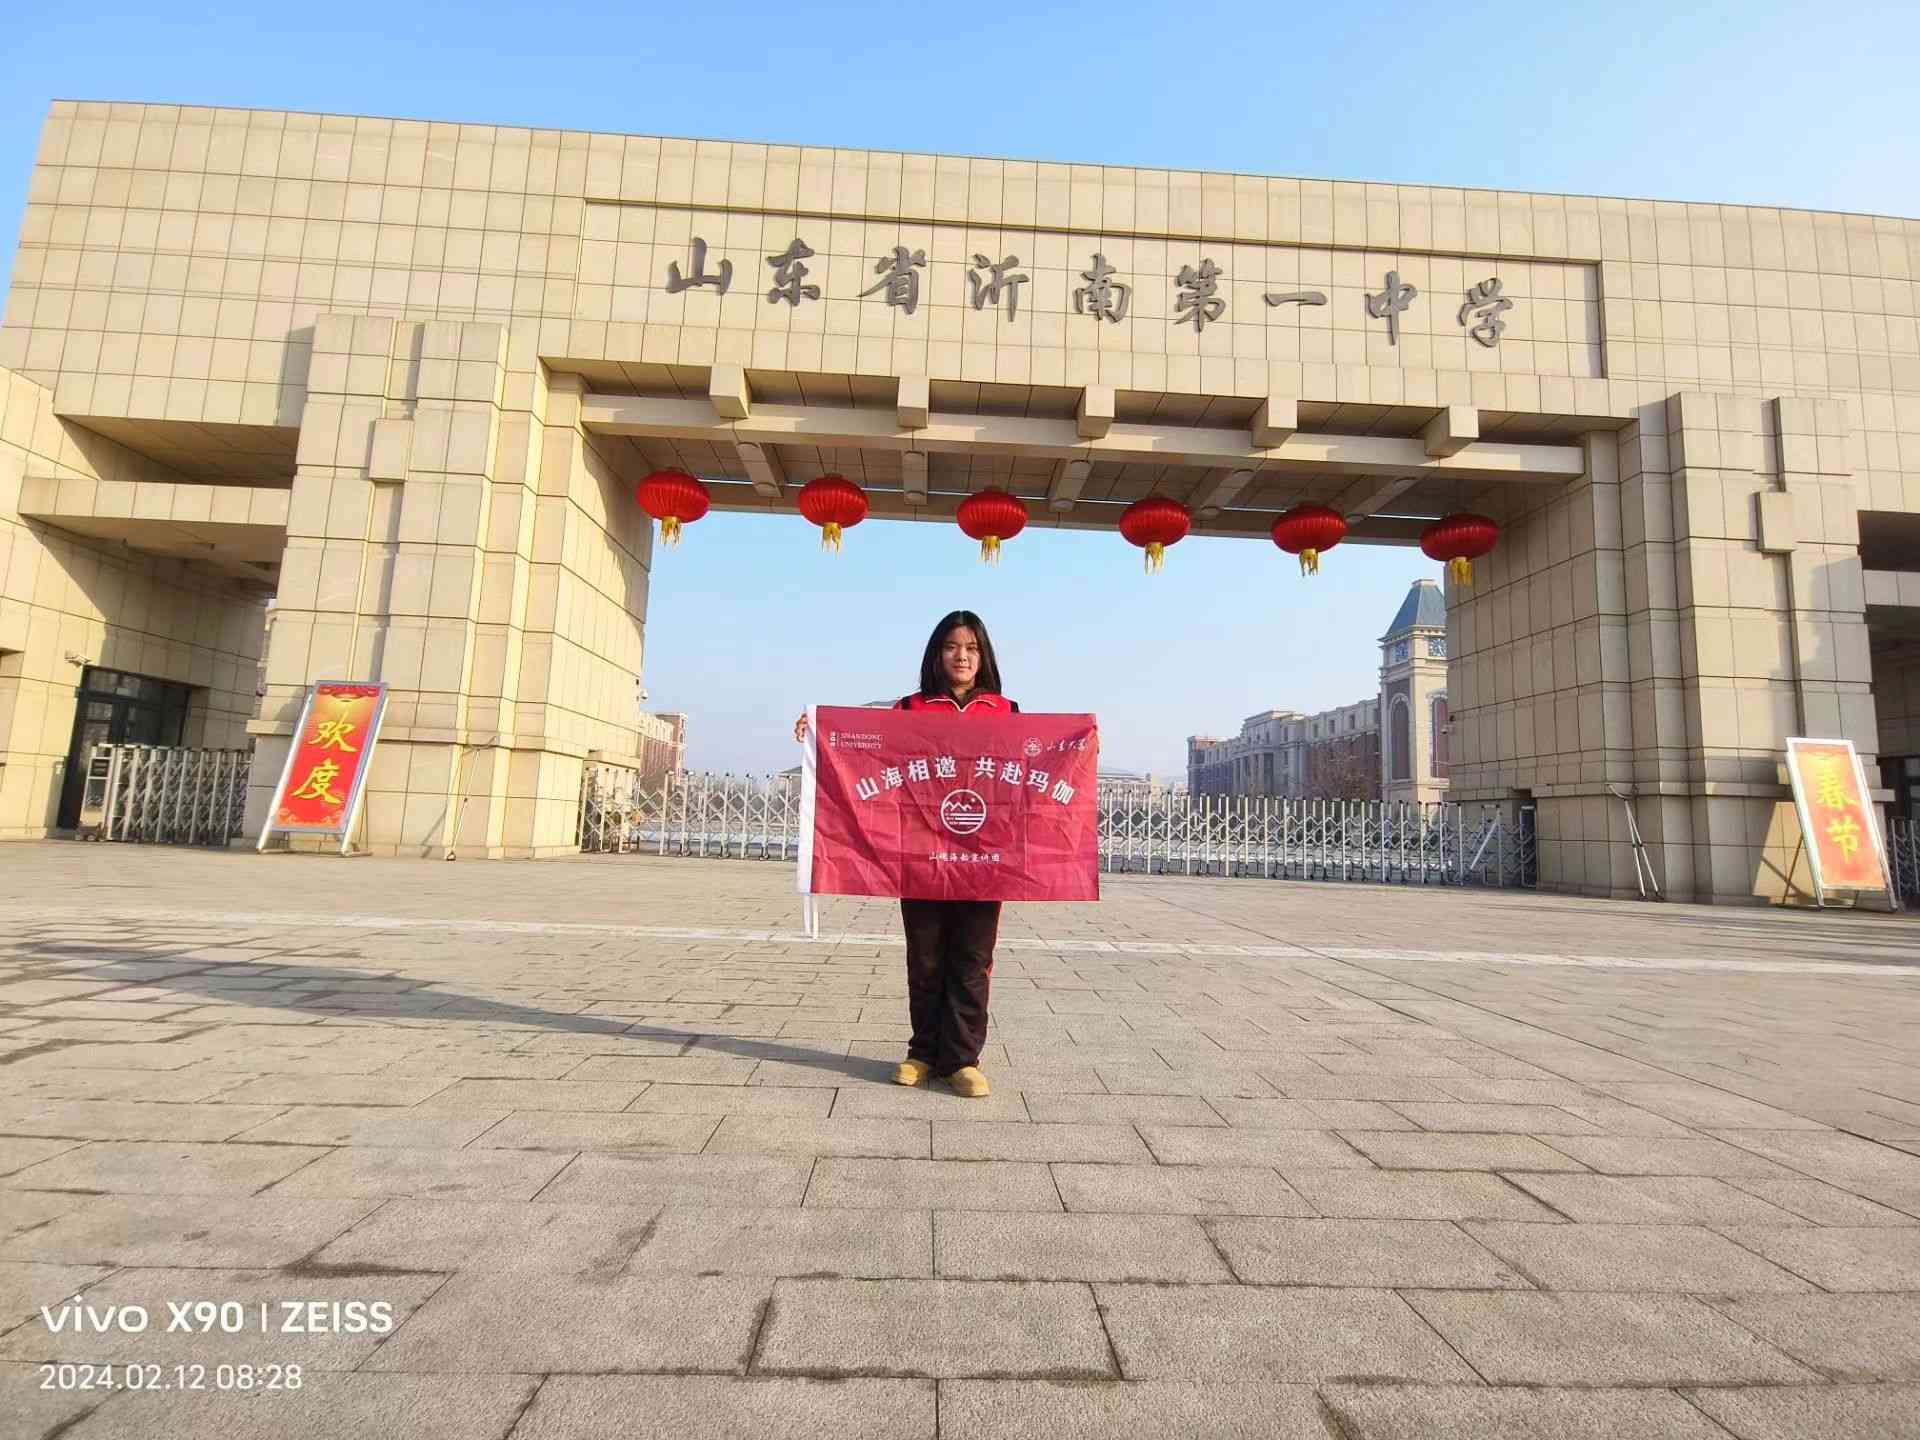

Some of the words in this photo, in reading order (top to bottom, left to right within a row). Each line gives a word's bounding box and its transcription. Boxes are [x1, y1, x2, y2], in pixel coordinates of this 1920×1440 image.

[665, 236, 1513, 348] 山东省沂南第一中学
[292, 711, 358, 805] 欢度
[855, 755, 957, 801] 山海相邀
[1815, 768, 1861, 865] 春节
